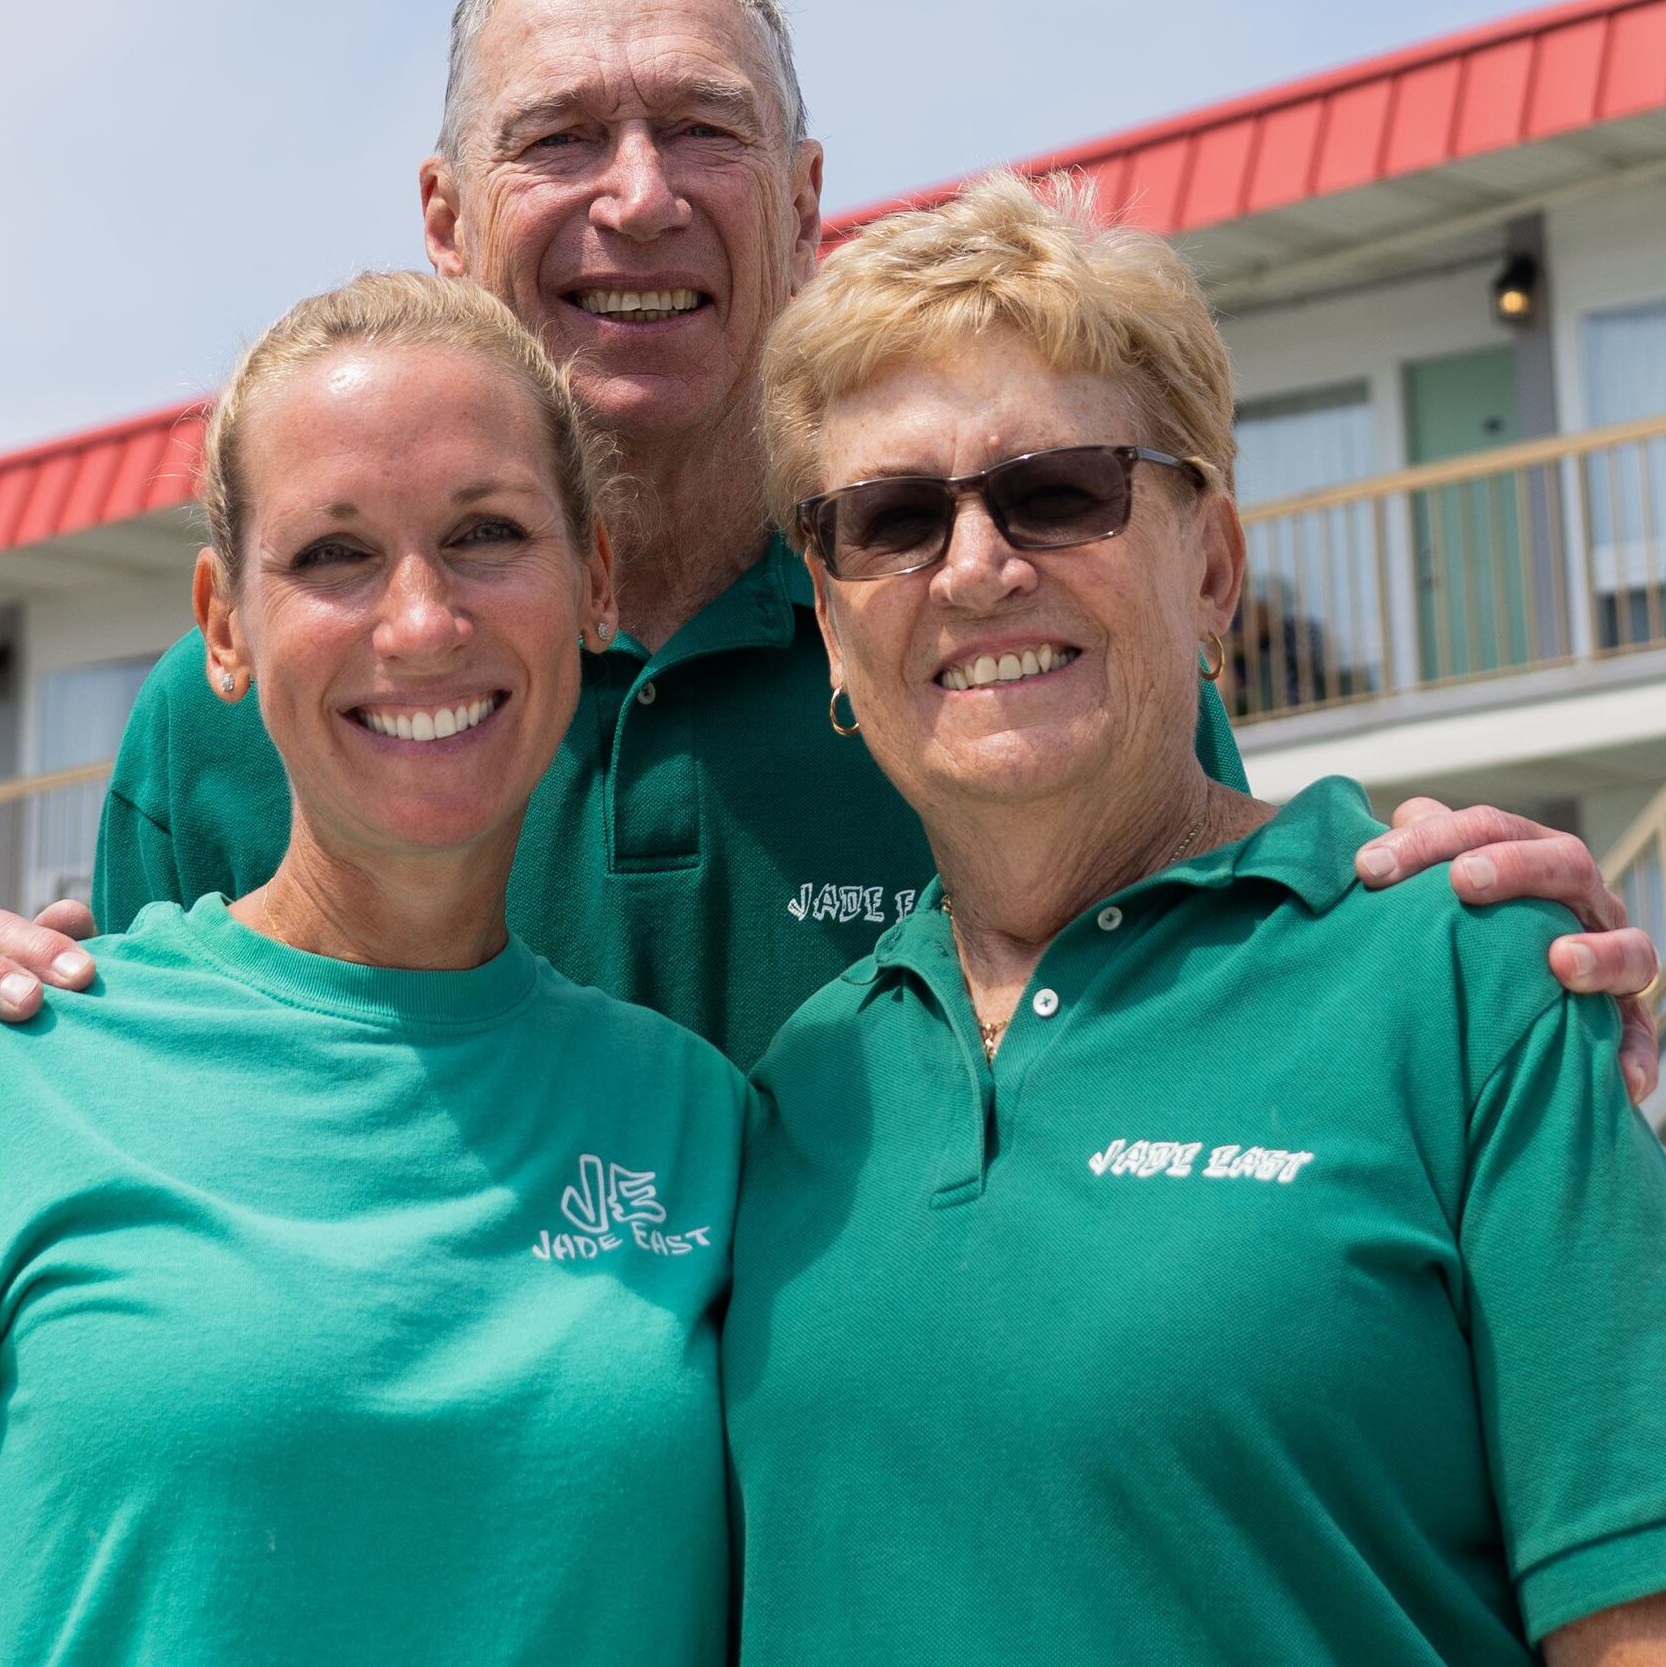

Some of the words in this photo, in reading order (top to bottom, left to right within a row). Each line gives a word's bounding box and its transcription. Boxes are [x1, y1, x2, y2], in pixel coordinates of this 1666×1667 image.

[787, 882, 885, 923] JADE
[1088, 1138, 1203, 1178] JADE
[1202, 1144, 1315, 1183] EAST
[532, 1230, 624, 1261] JADE
[631, 1221, 711, 1257] EAST
